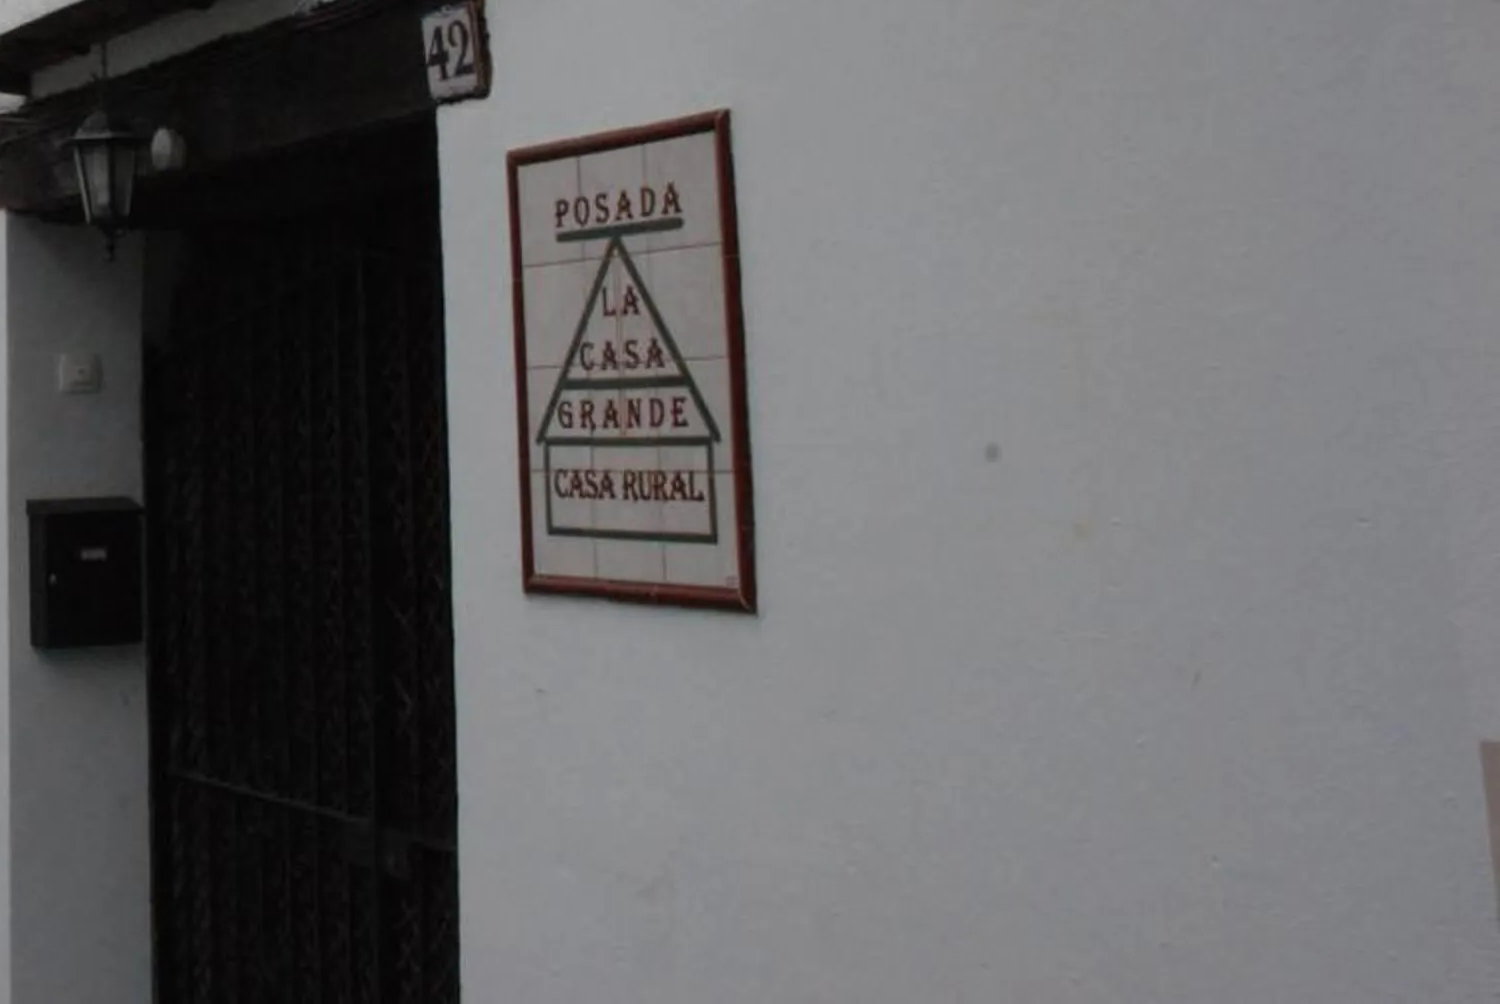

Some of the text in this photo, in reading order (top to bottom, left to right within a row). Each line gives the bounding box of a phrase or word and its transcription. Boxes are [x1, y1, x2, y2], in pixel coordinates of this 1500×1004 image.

[426, 19, 475, 81] 42
[555, 181, 683, 228] POSADA
[602, 285, 640, 317] LA
[579, 337, 666, 372] CASA
[557, 396, 689, 430] GRANDE
[554, 468, 705, 503] CASA RURAL
